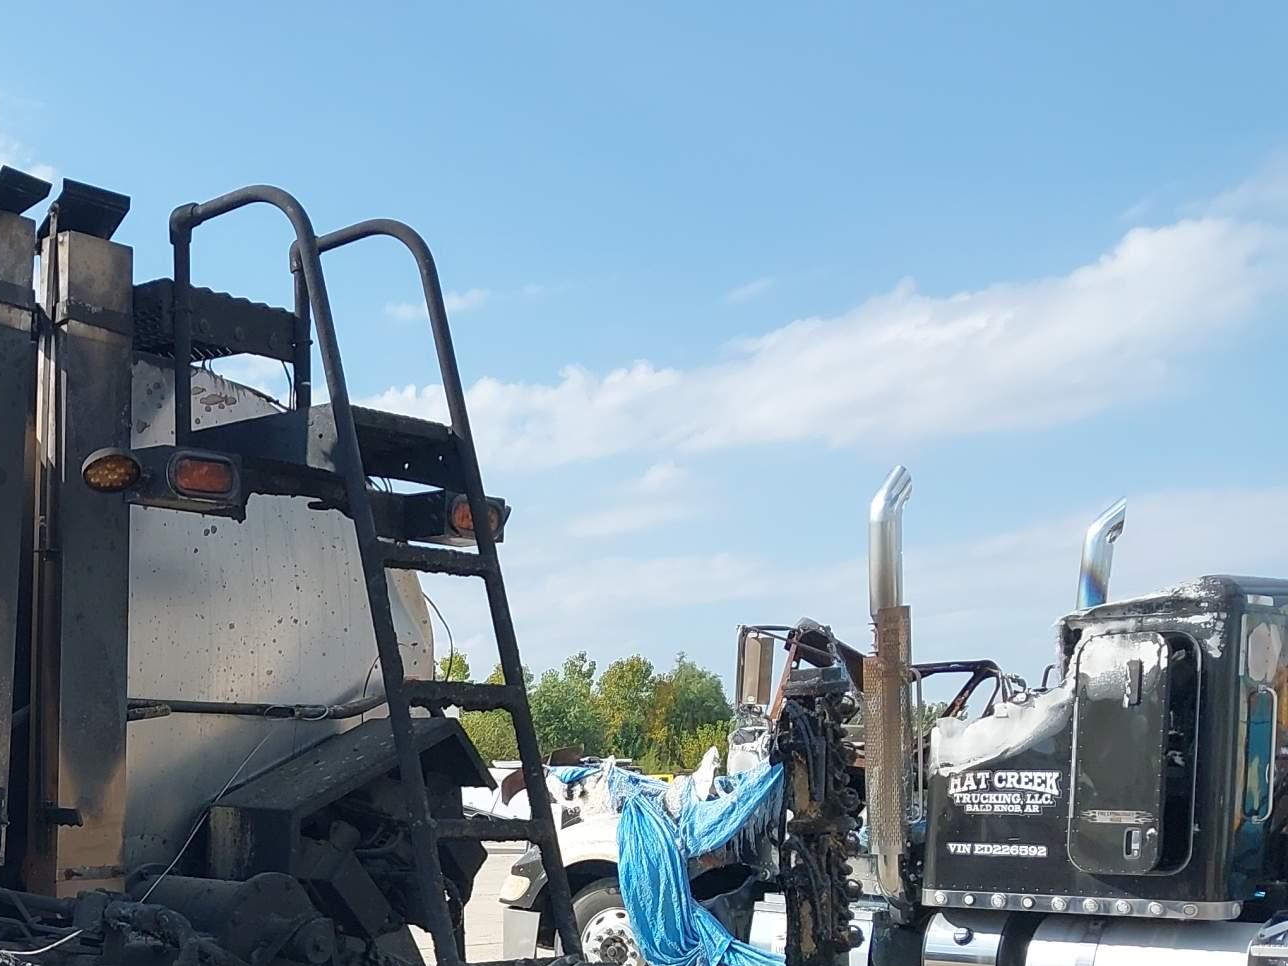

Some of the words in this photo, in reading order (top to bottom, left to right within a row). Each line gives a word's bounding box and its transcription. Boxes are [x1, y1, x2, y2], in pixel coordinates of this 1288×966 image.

[949, 772, 990, 795] HAT
[993, 771, 1060, 796] CREEK
[954, 793, 1024, 805] TRUCKING,
[1025, 793, 1054, 804] LLC.
[966, 804, 992, 812] BALD
[993, 804, 1023, 813] KNOB,
[1023, 805, 1041, 813] AR
[948, 843, 972, 854] VIN
[973, 844, 1048, 857] ED226592
